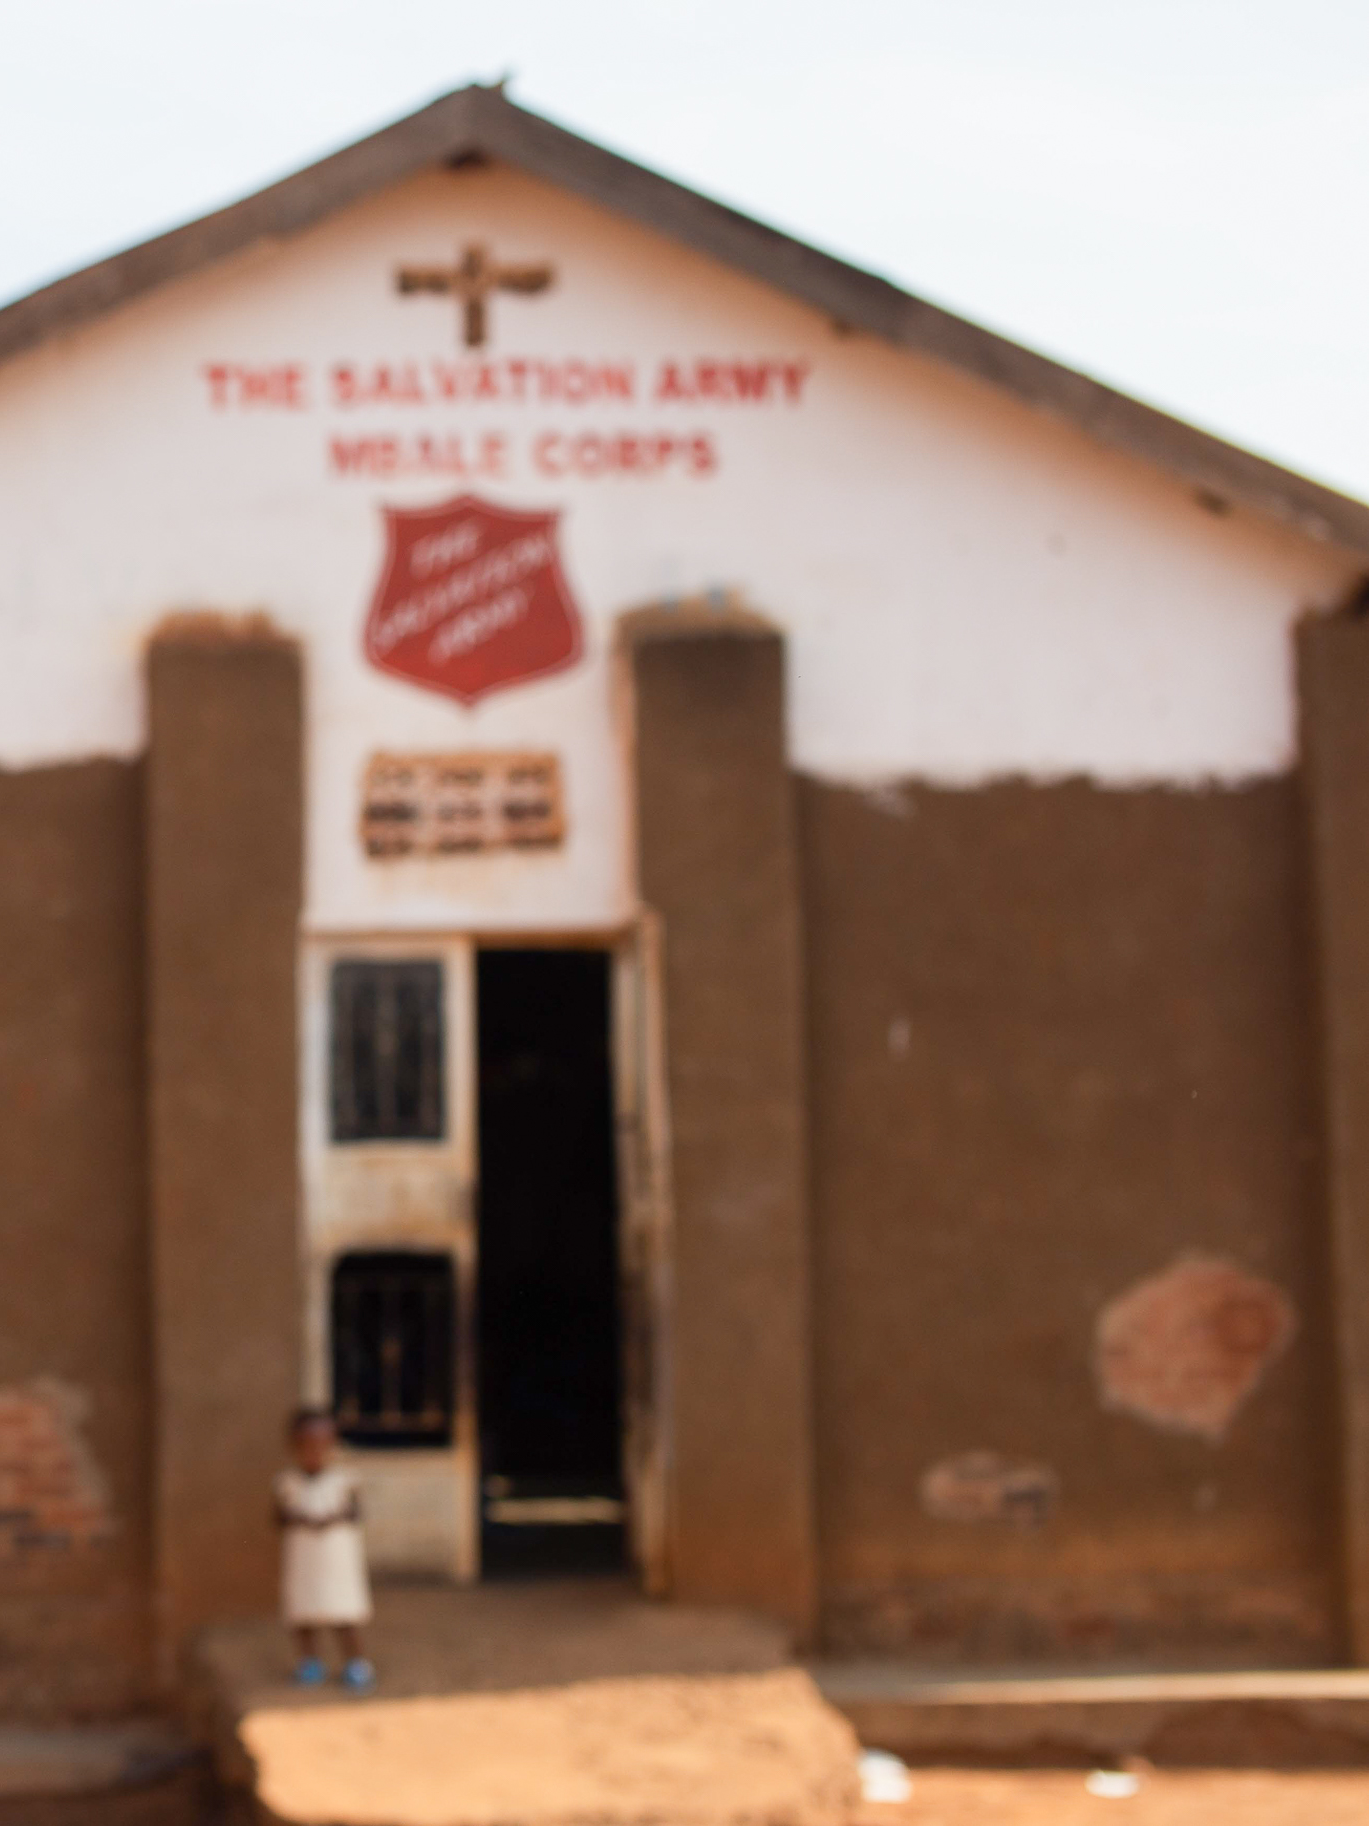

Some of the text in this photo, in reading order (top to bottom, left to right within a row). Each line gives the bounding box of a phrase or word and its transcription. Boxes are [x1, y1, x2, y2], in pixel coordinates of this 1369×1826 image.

[204, 356, 813, 409] THE SALVATION ARMY
[533, 430, 717, 476] CORPS
